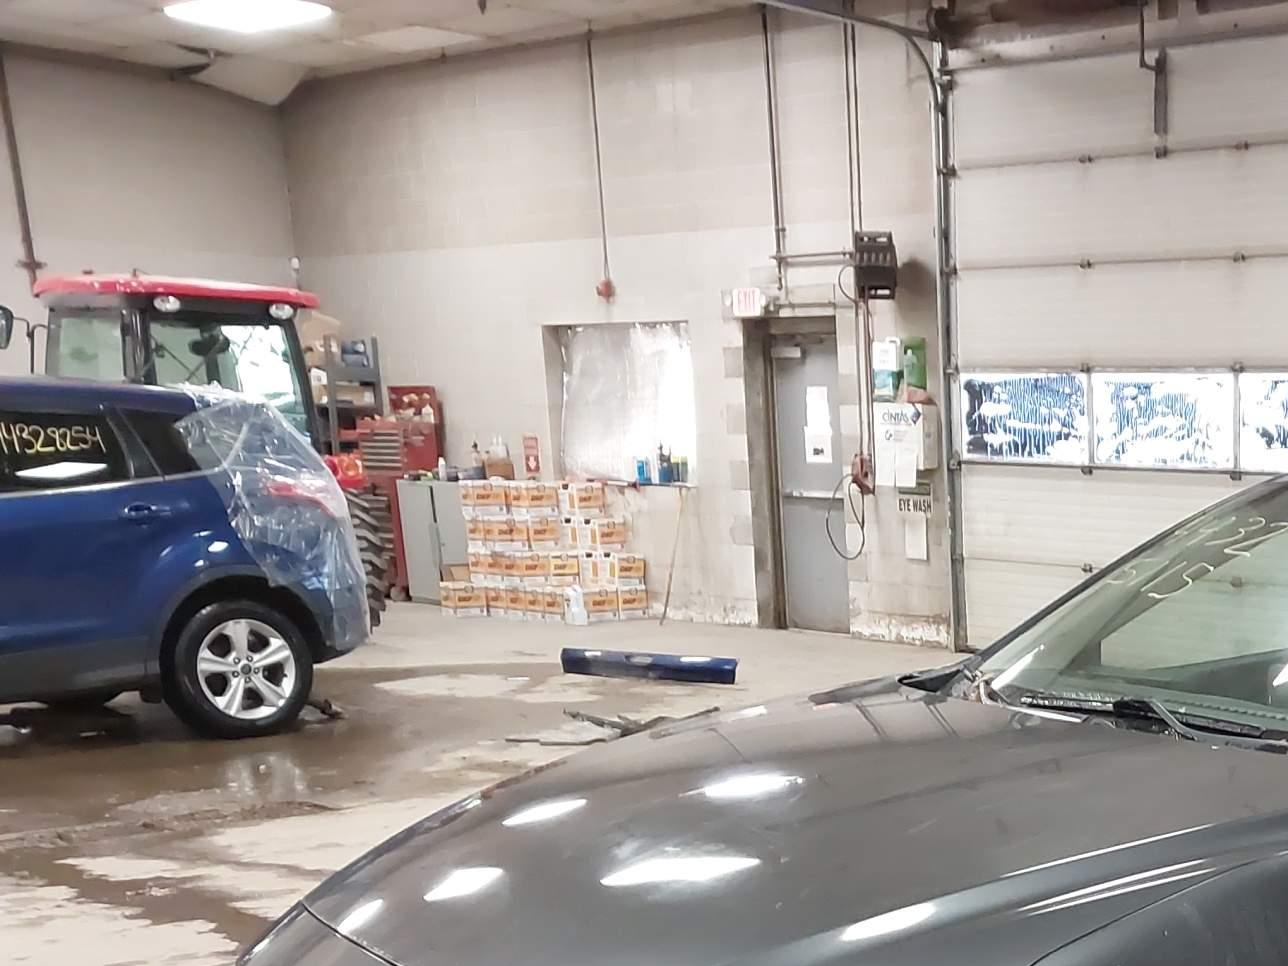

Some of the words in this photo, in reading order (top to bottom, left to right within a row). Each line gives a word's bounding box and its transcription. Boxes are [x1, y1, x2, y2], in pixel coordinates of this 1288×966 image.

[737, 289, 756, 312] EXIT
[898, 498, 911, 512] EYE
[912, 498, 932, 513] WASH
